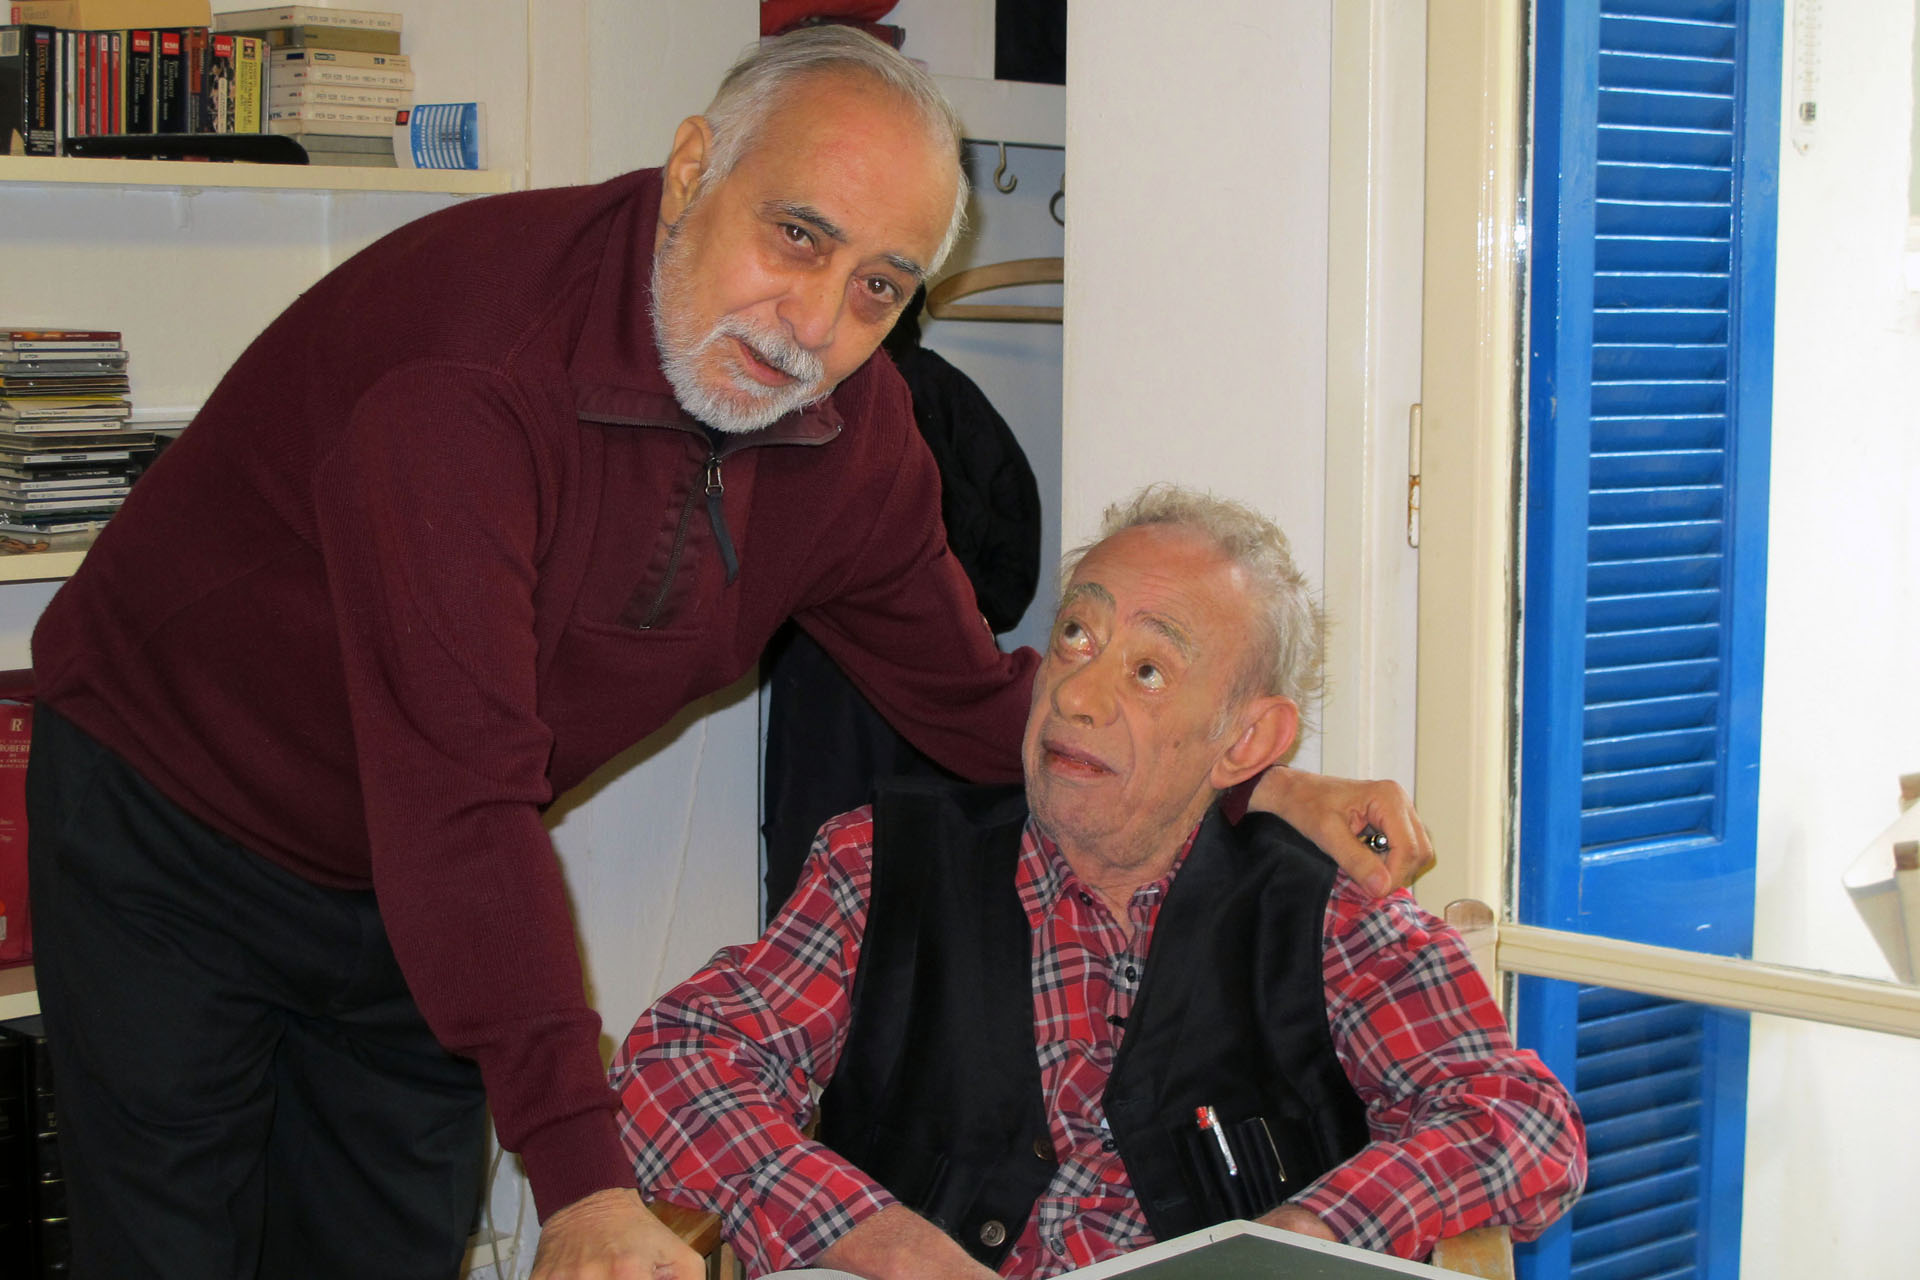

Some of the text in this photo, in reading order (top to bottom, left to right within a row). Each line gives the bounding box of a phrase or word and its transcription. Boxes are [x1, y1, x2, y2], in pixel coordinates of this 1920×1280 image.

[134, 39, 150, 47] EMI
[164, 41, 179, 49] EMI
[9, 718, 24, 732] R
